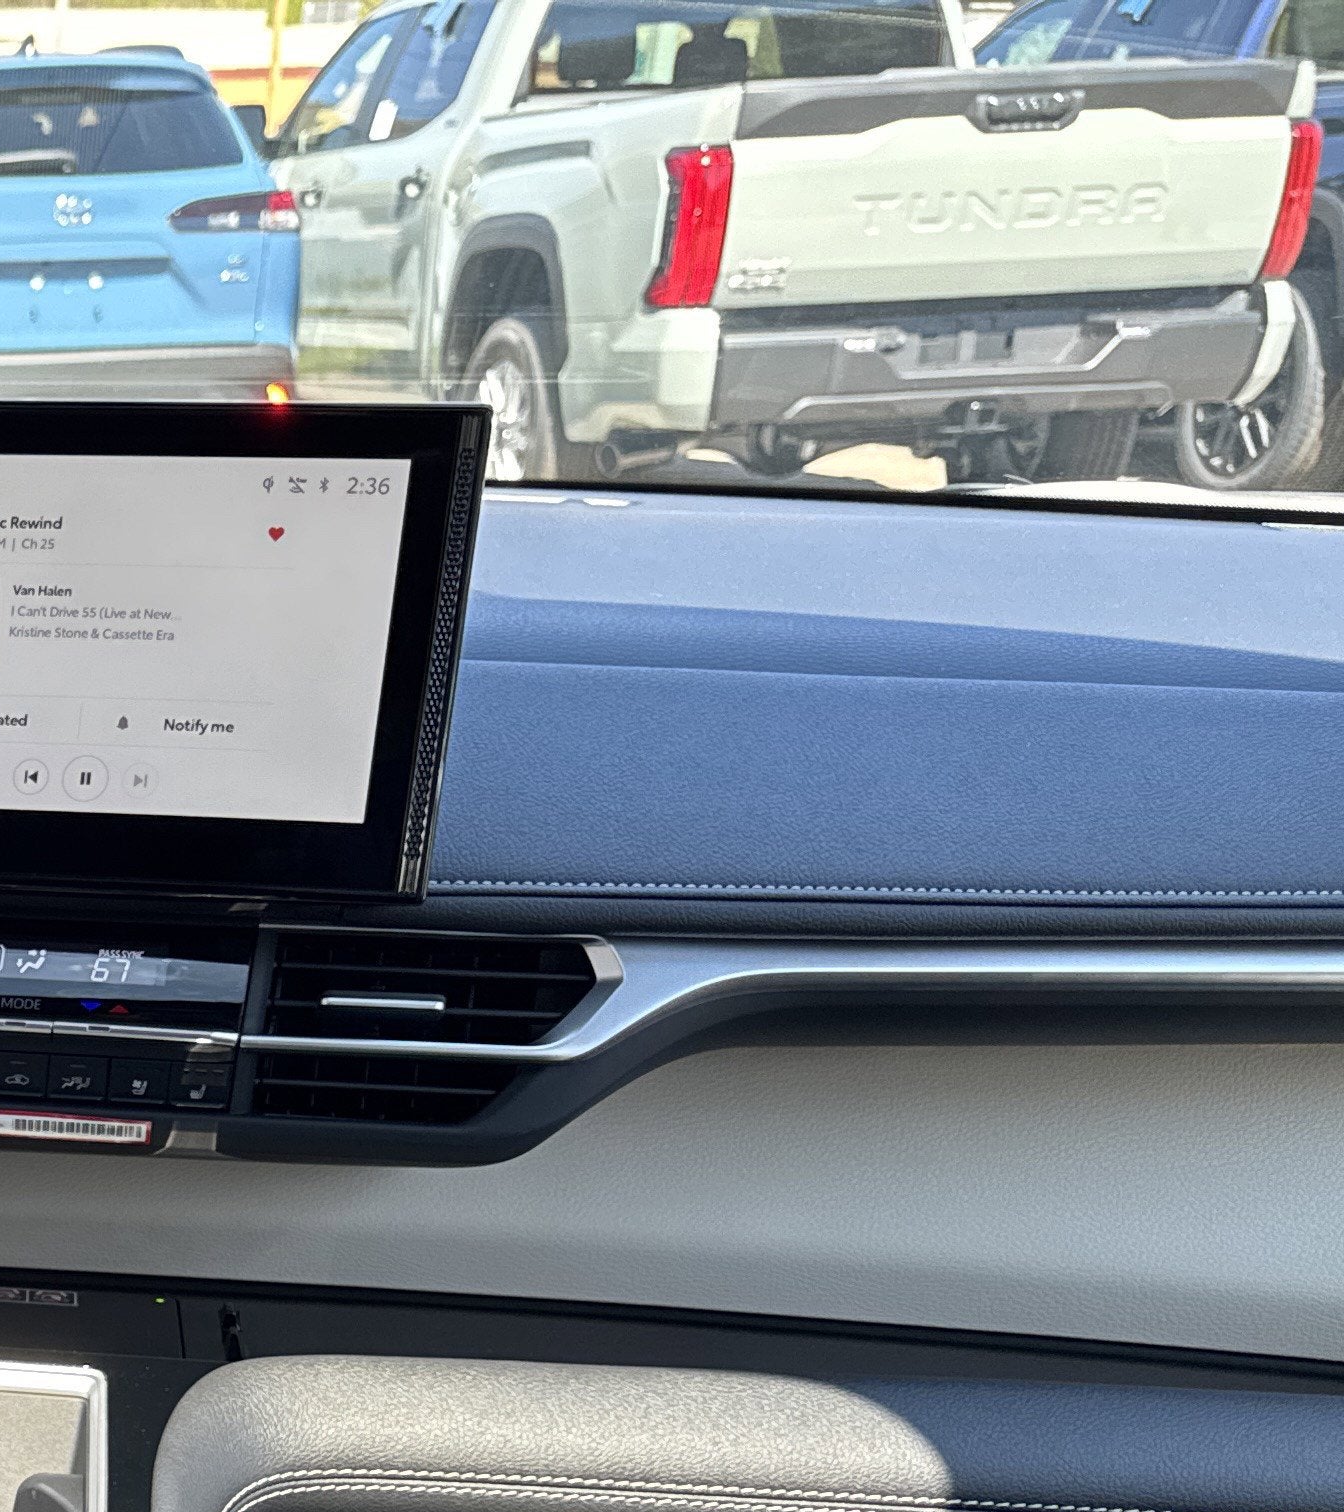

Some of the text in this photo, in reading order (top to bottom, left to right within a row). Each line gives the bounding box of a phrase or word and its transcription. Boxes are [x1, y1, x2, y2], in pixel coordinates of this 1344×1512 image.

[853, 182, 1169, 236] TUNDRA
[346, 476, 391, 496] 2:36
[10, 515, 63, 530] Rewind
[21, 538, 37, 550] Ch
[39, 538, 55, 550] 25
[12, 585, 72, 598] Van Halen
[17, 606, 47, 618] Can't
[49, 606, 79, 619] Drive
[81, 608, 98, 619] 55
[99, 607, 128, 621] (Live
[130, 609, 142, 620] at
[9, 626, 175, 641] Kristine Stone & Cassette Era
[163, 718, 235, 736] Notify me
[98, 949, 121, 958] PASS
[91, 957, 131, 983] 67
[0, 996, 42, 1010] MODE
